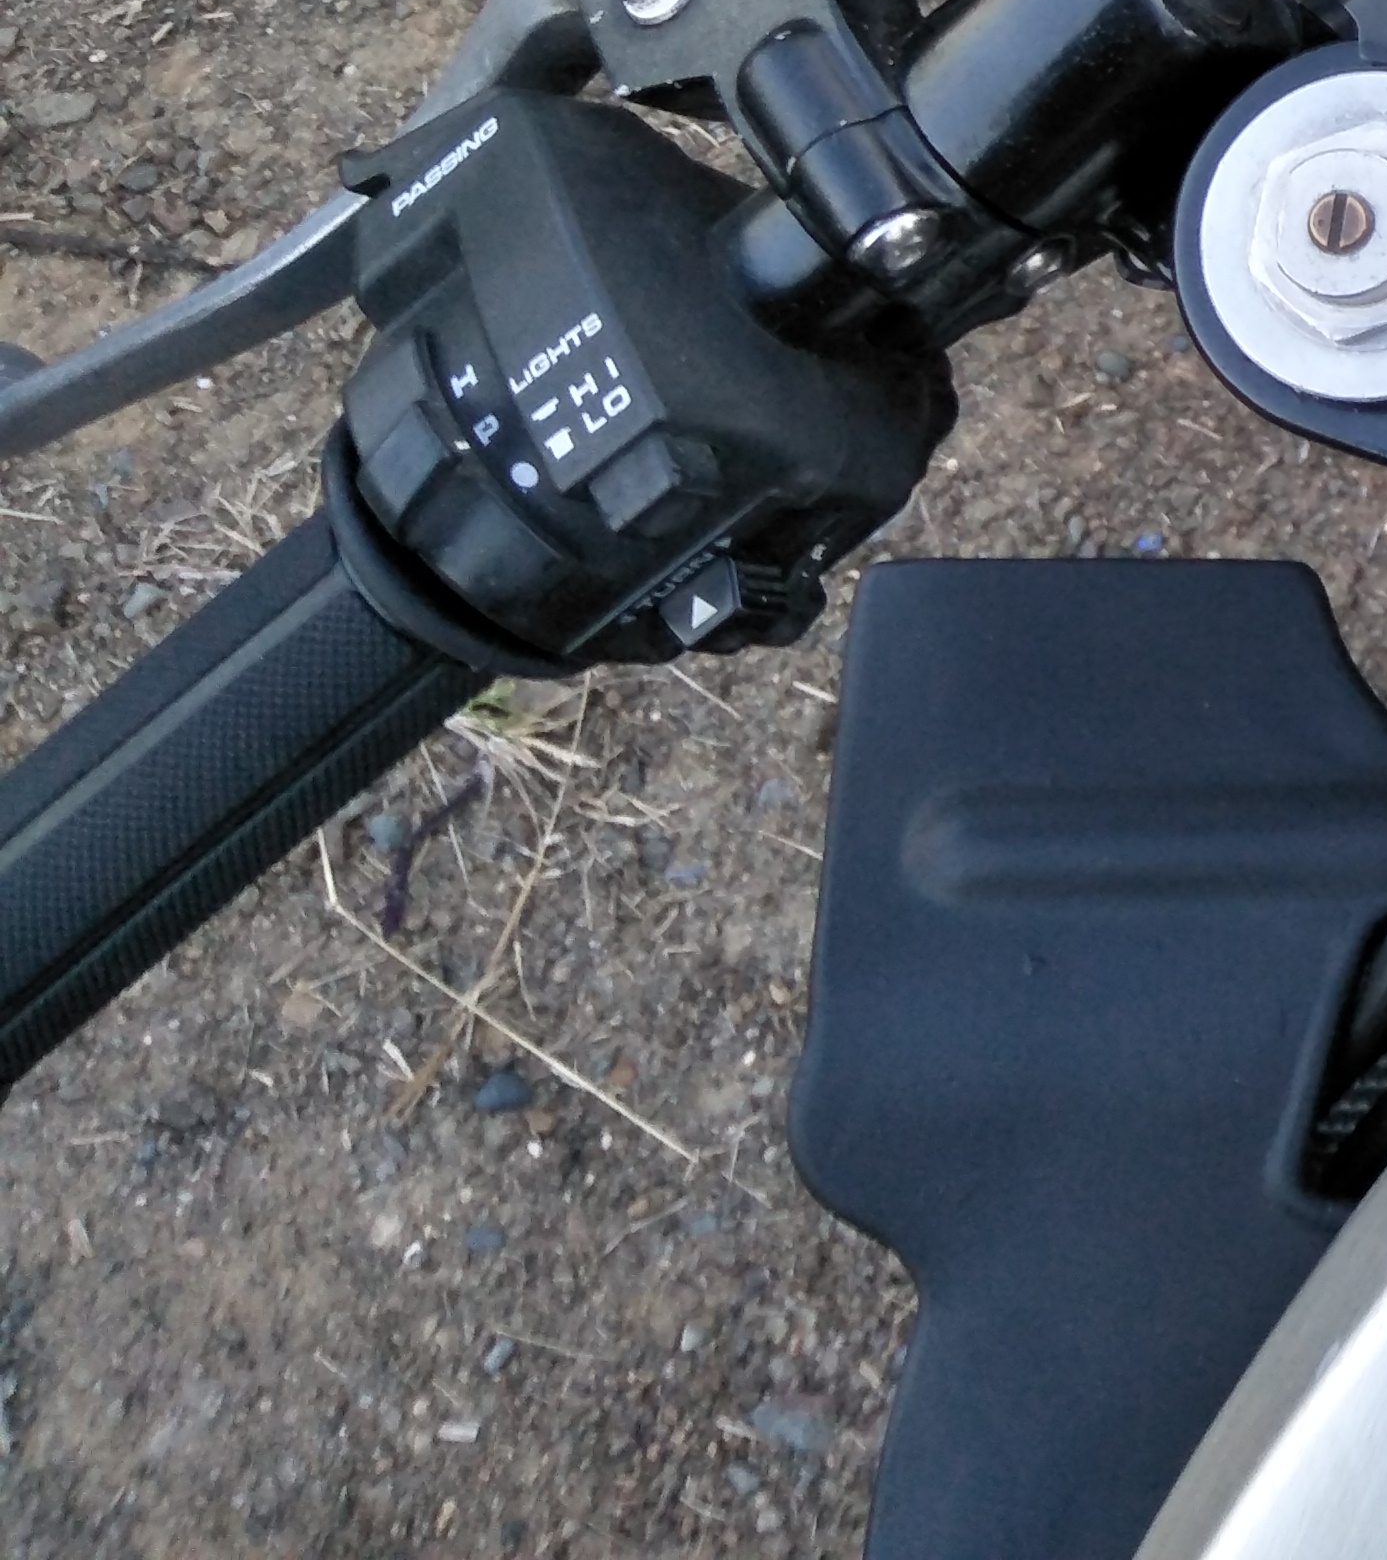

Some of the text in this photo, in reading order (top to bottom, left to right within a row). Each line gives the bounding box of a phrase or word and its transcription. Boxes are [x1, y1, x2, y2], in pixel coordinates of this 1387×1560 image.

[391, 116, 498, 218] PASSING
[508, 312, 603, 397] LIGHTS
[568, 356, 620, 408] HI
[473, 413, 501, 446] P
[581, 388, 632, 435] LO
